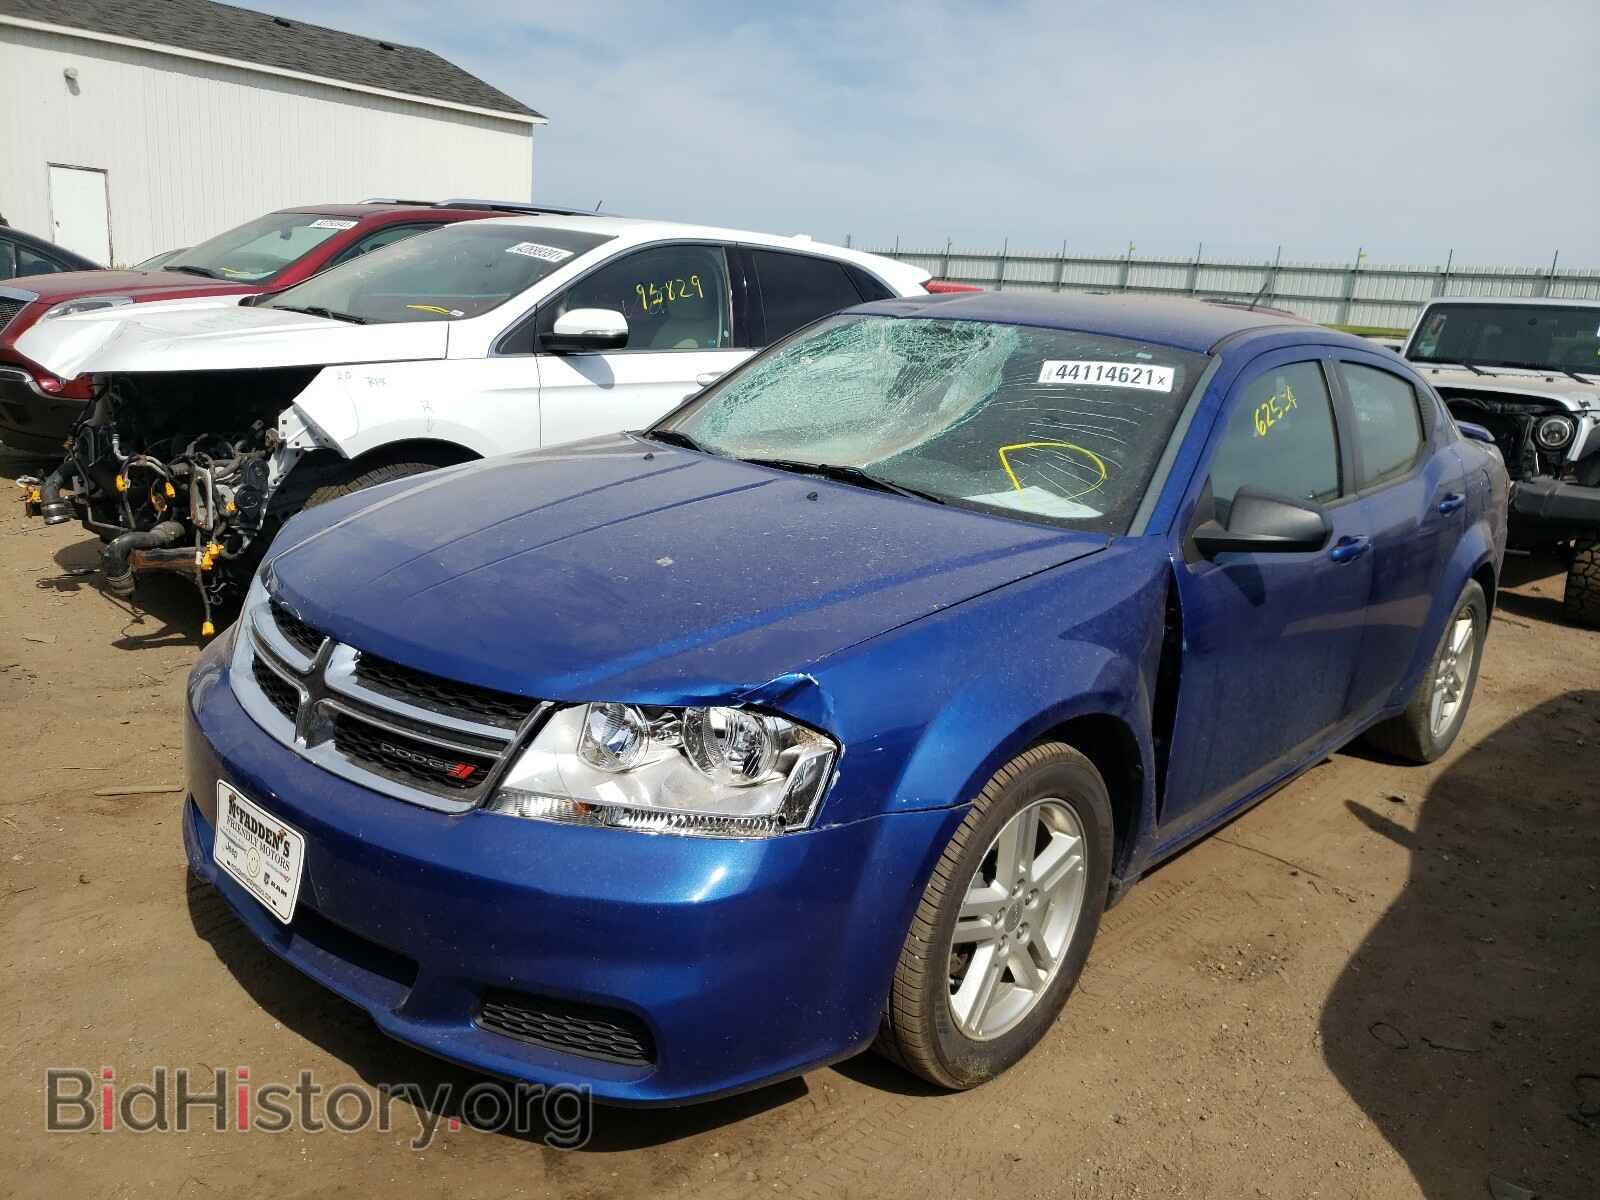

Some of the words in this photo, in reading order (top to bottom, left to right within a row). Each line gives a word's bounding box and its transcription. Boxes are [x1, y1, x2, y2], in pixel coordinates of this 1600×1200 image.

[381, 743, 449, 772] DODGE
[227, 815, 259, 849] FRIENDLY
[259, 842, 291, 872] MOTORS
